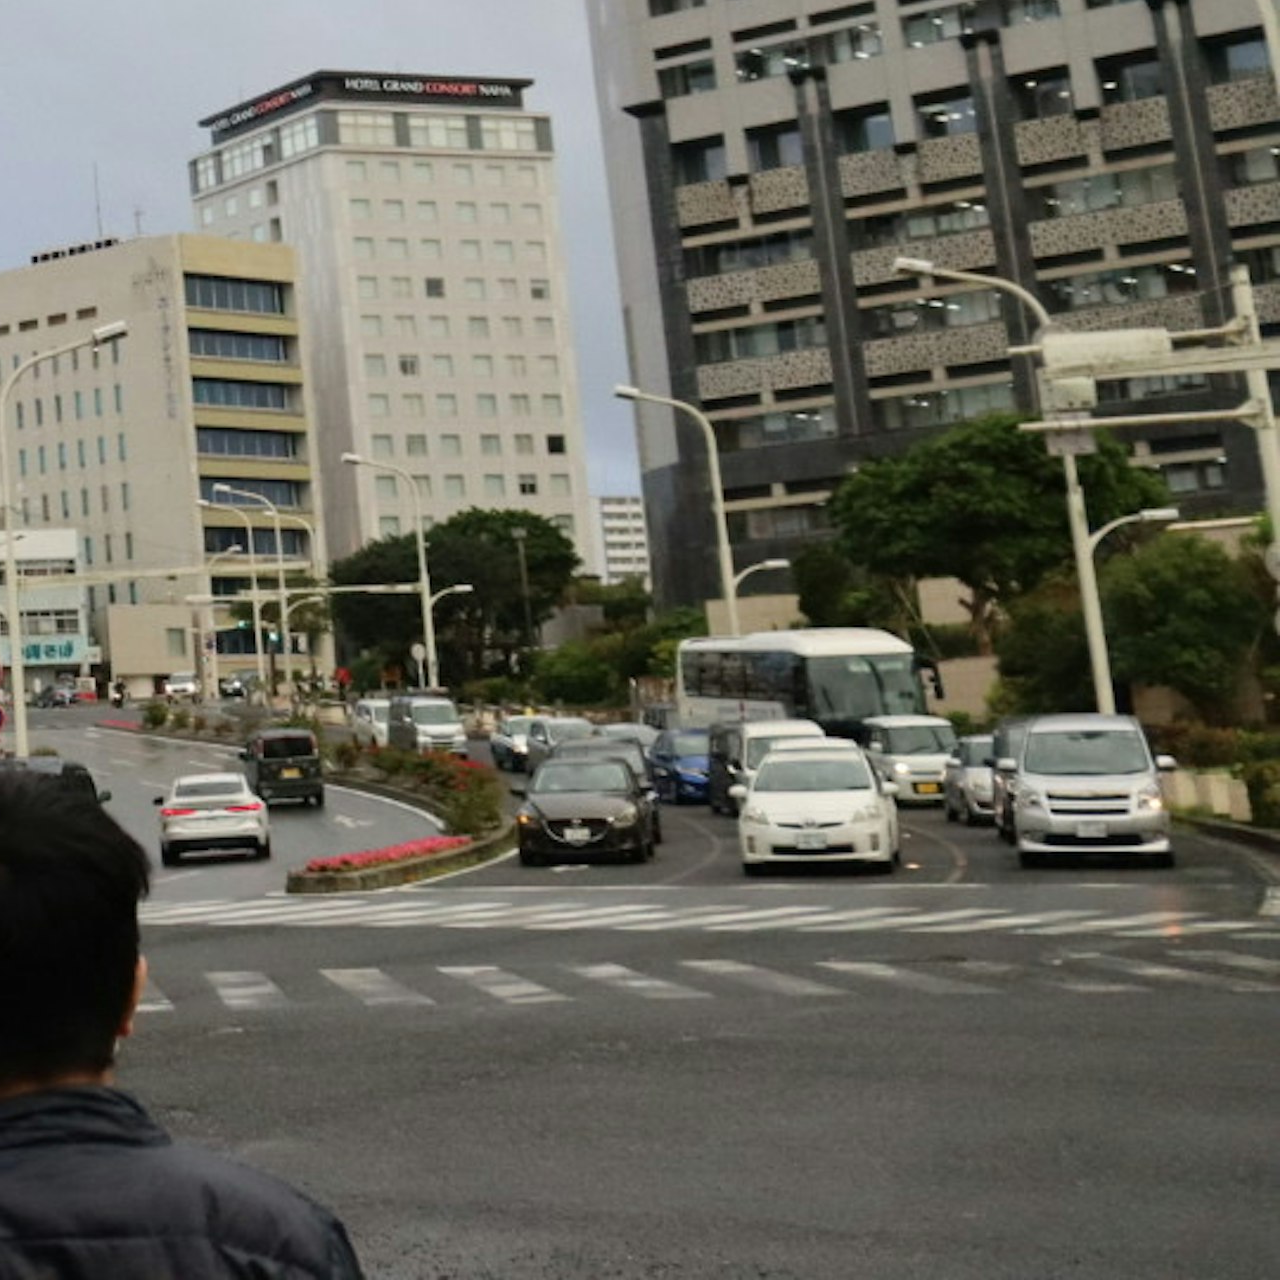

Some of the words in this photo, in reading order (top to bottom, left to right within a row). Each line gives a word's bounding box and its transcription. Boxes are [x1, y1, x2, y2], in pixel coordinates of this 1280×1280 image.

[345, 78, 381, 91] HOTEL
[383, 81, 426, 93] GRAND
[426, 82, 478, 95] CONSORT
[479, 84, 513, 97] NAHA
